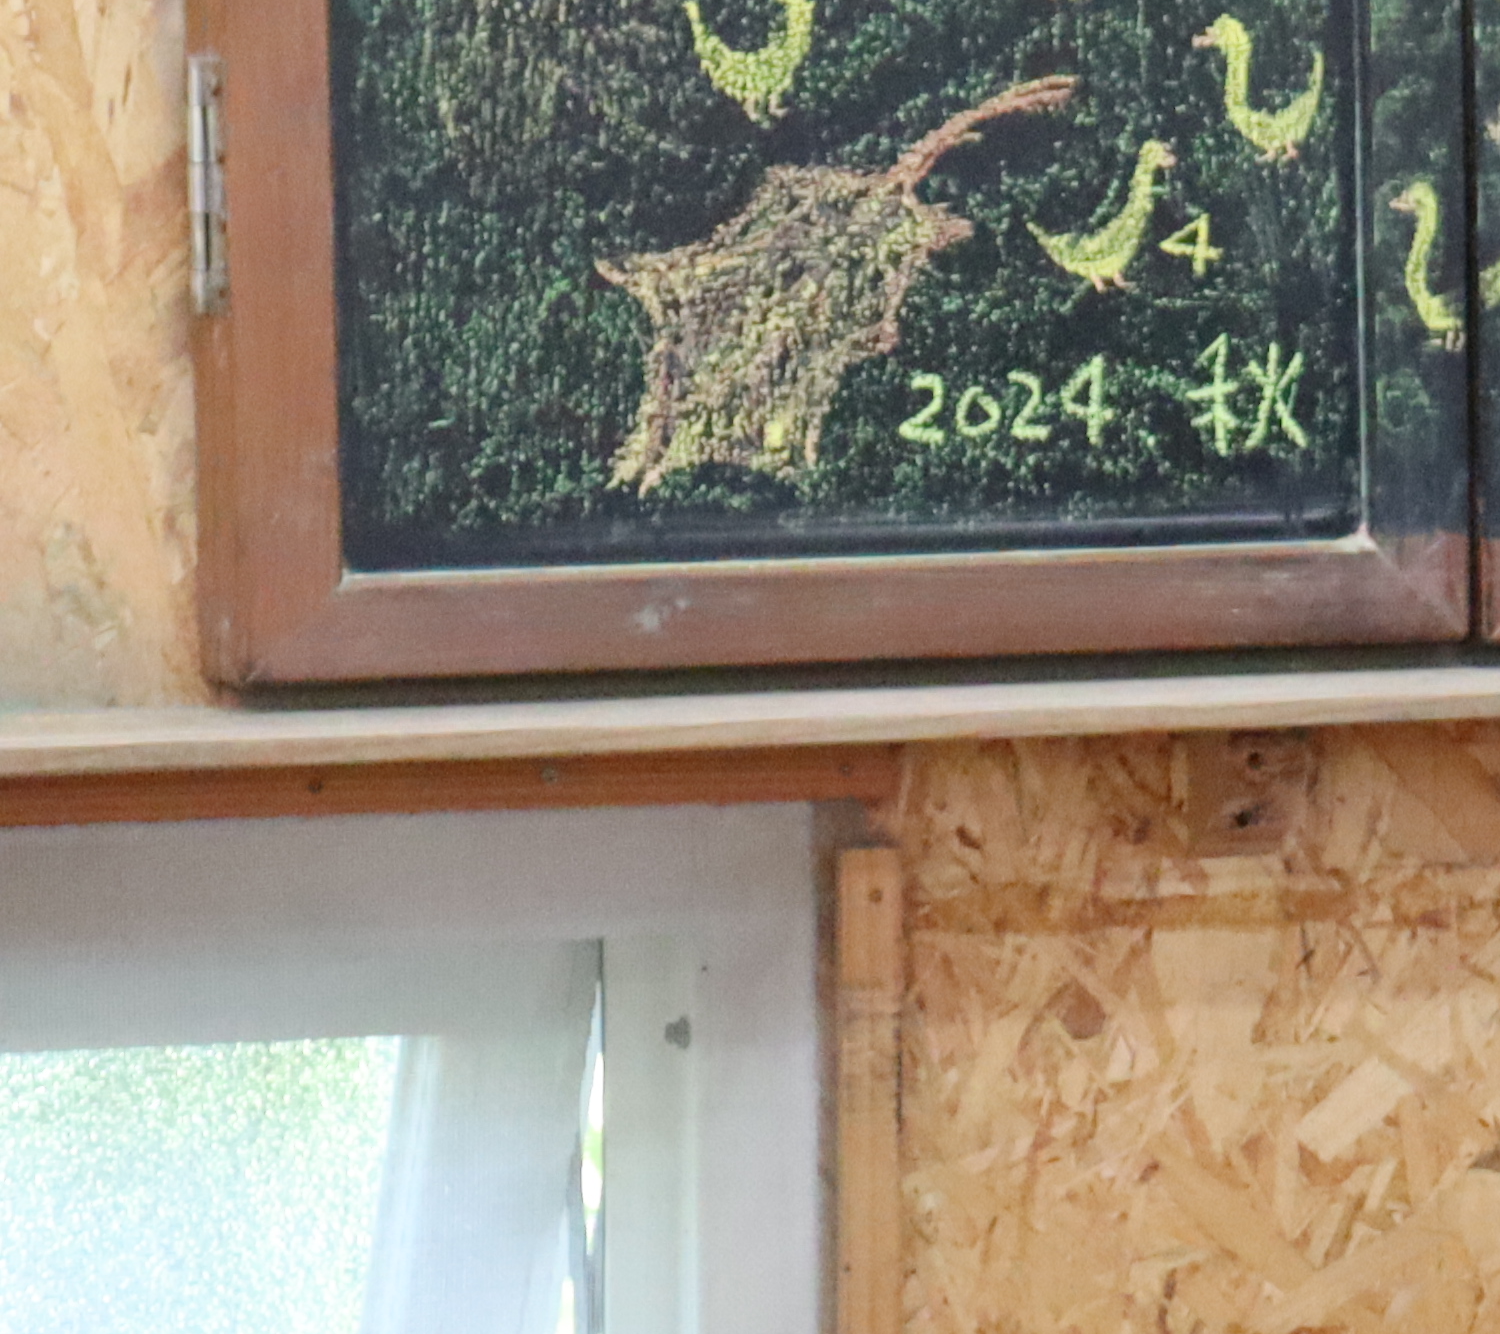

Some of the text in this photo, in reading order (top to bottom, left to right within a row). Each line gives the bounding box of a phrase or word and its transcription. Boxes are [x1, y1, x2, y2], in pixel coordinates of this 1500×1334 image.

[1159, 212, 1223, 277] 4
[899, 332, 1308, 456] 2024 秋
